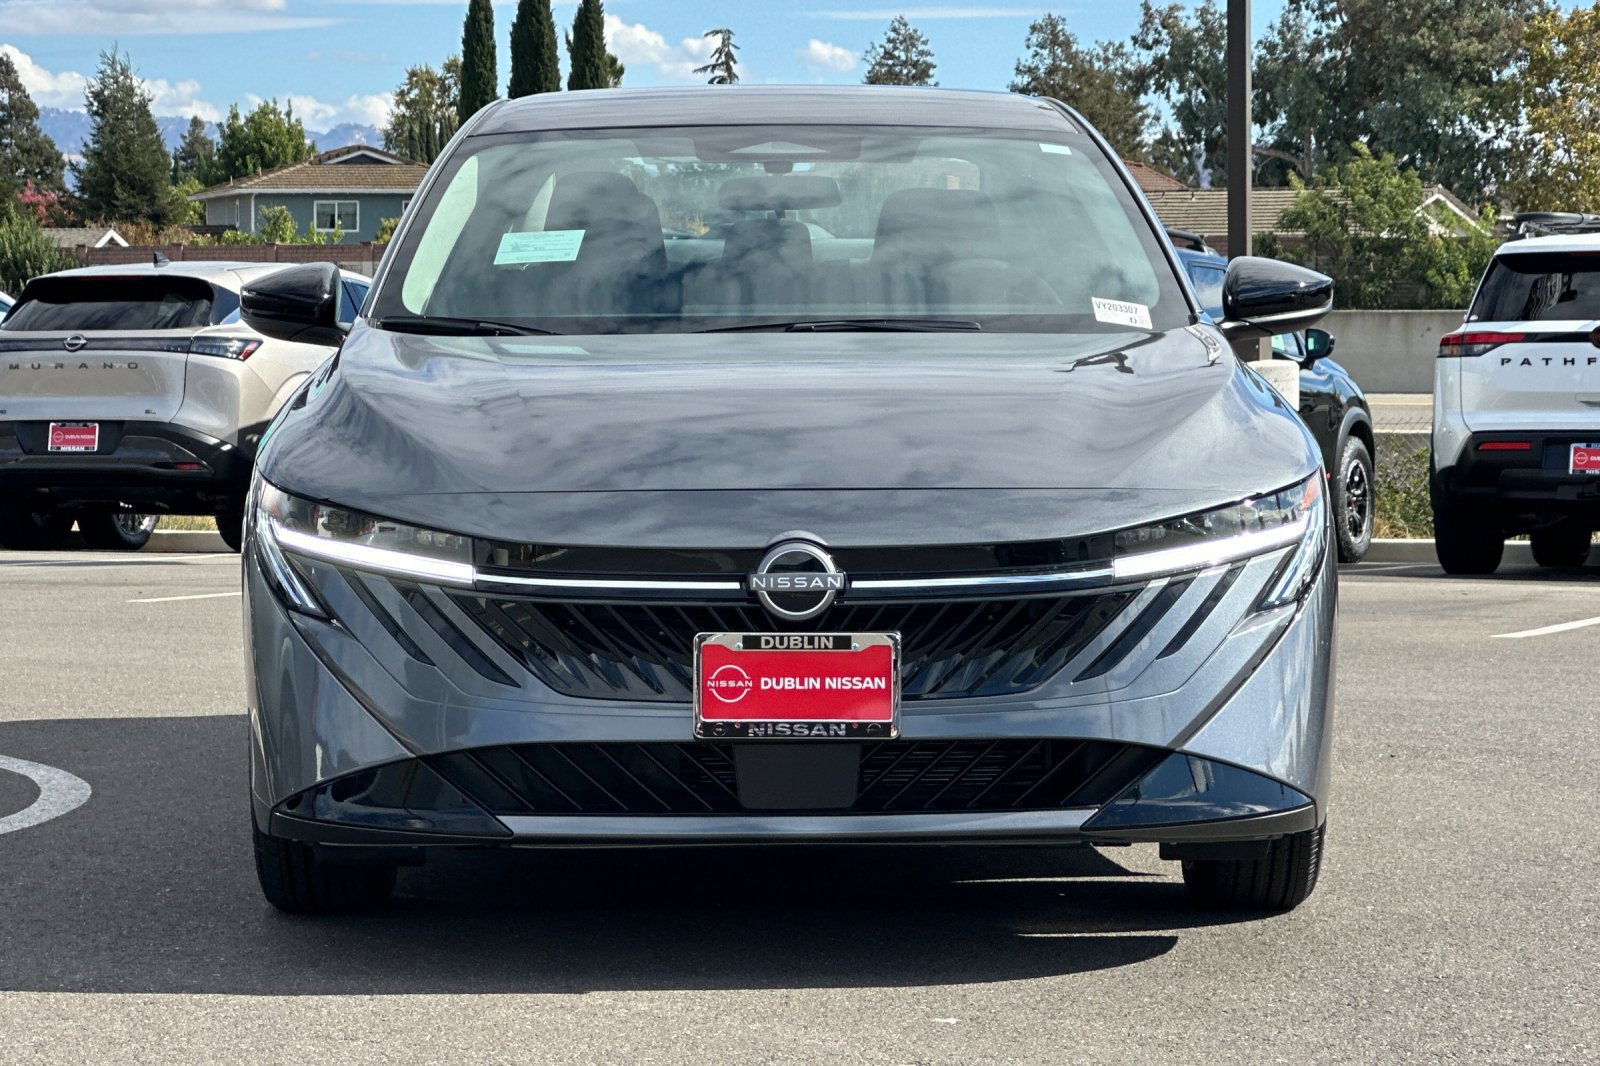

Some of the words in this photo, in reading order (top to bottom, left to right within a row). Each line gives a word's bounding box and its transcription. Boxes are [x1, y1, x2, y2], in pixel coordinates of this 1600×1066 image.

[1095, 301, 1138, 314] VY203307
[9, 362, 139, 370] MURANO
[1501, 357, 1598, 366] PATHF
[752, 577, 841, 588] NISSAN
[760, 636, 834, 649] DUBLIN
[707, 680, 753, 688] NISSAN
[760, 677, 821, 690] DUBLIN
[825, 677, 886, 690] NISSAN
[748, 723, 847, 737] NISSAN
